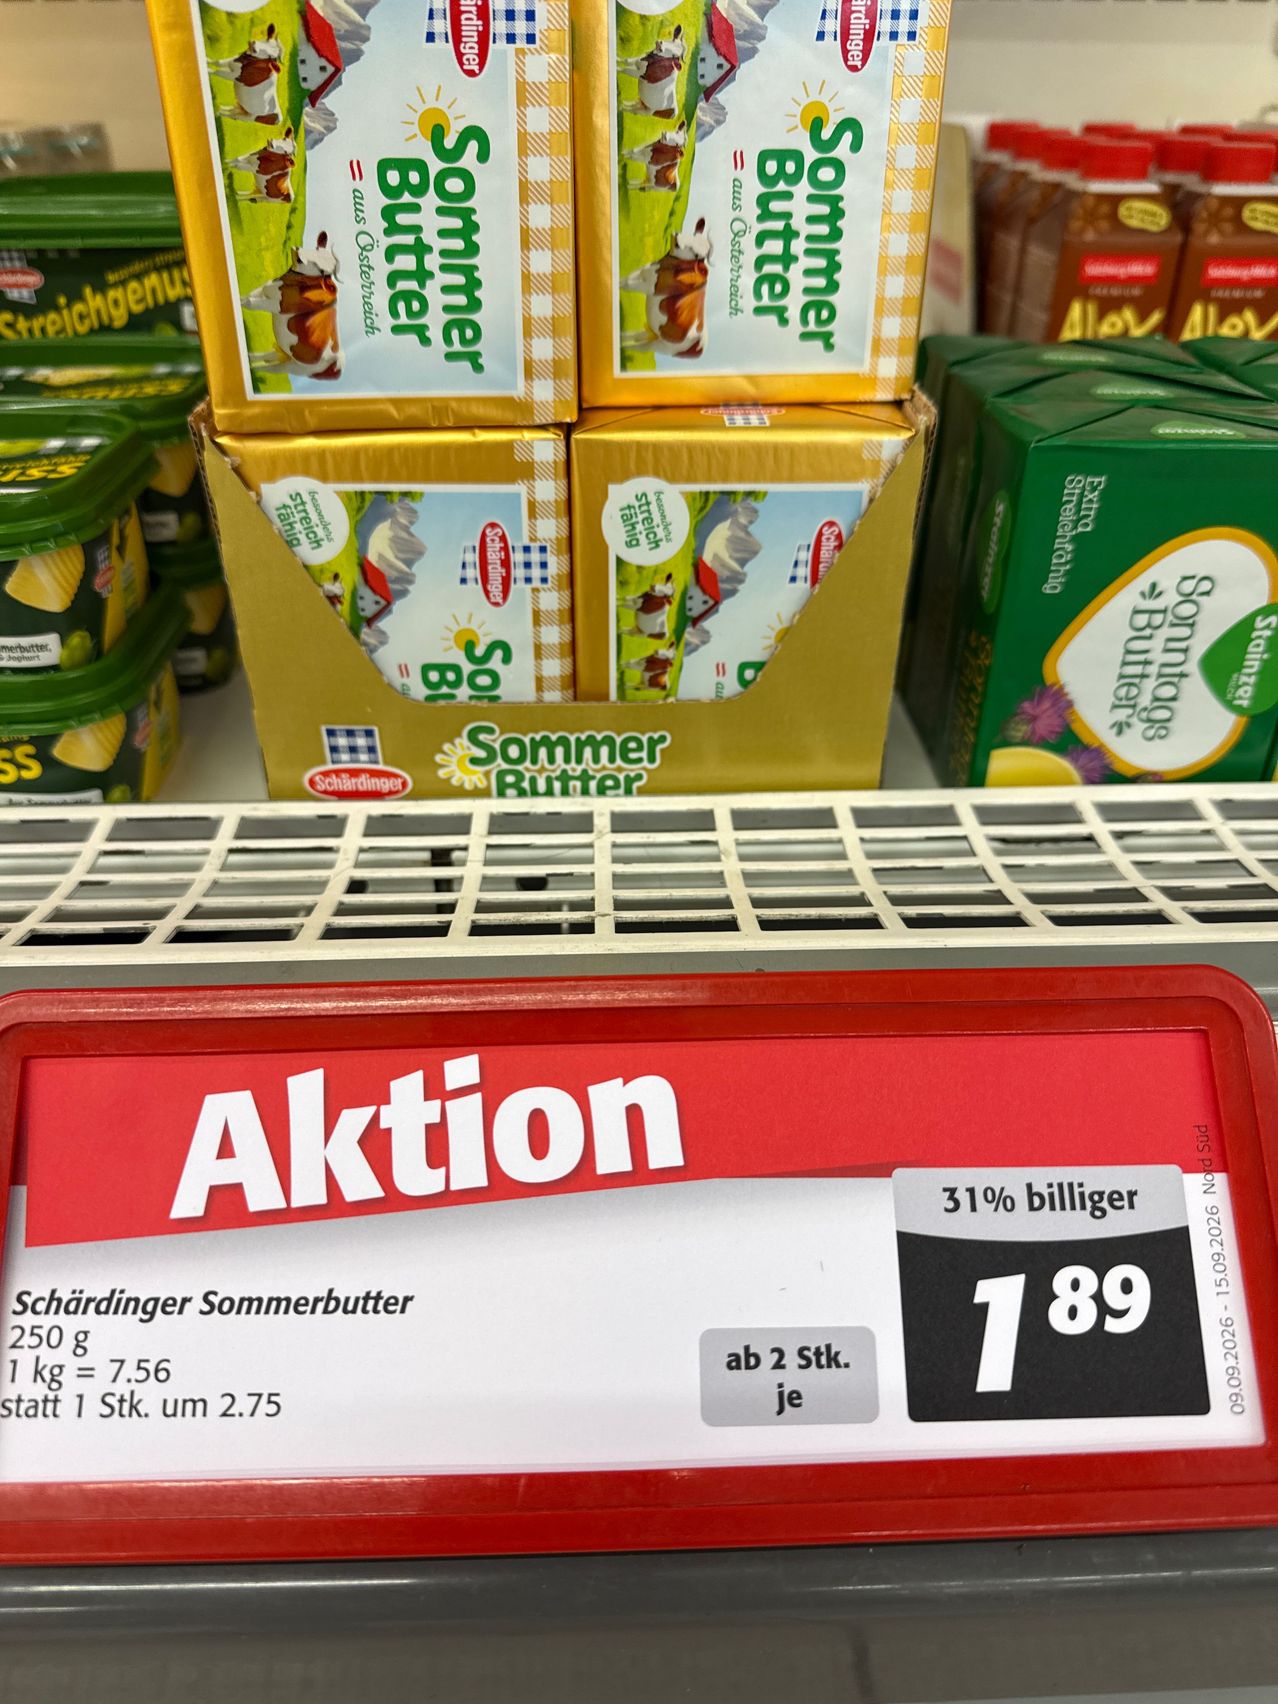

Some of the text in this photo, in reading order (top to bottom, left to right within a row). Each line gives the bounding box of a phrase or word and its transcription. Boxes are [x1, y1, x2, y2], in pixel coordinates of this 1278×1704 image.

[352, 188, 381, 338] aus Österreich
[376, 157, 435, 348] Butter
[430, 123, 491, 375] Sommer
[729, 177, 752, 318] aus Österreich
[752, 148, 805, 328] Butter
[798, 116, 864, 353] Sommer
[289, 492, 323, 551] streich
[308, 489, 334, 543] besonders
[619, 503, 642, 549] fähig
[635, 492, 663, 551] streich
[654, 490, 673, 543] besonders
[1077, 475, 1107, 533] Extra
[1041, 474, 1085, 595] Streichfähig
[485, 526, 507, 606] Schärdinger
[0, 643, 52, 654] merbutter,
[464, 639, 513, 702] So
[1109, 605, 1168, 719] Butter
[1137, 575, 1216, 742] Sonntags
[1232, 613, 1278, 708] Stainzer
[421, 662, 464, 702] B
[467, 725, 668, 767] Sommer
[314, 775, 404, 794] Schärdinger
[495, 768, 645, 797] Butter
[168, 1053, 685, 1220] Aktion
[1192, 1124, 1211, 1152] Süd
[942, 1181, 1139, 1220] 31% billiger
[1196, 1158, 1216, 1195] Nord
[1205, 1204, 1231, 1297] 15.09.2026
[11, 1288, 415, 1323] Schärdinger Sommerbutter
[972, 1263, 1152, 1393] 1 89
[8, 1325, 91, 1357] 250 g
[726, 1342, 851, 1371] ab 2 Stk.
[1219, 1316, 1245, 1415] 09.09.2026
[8, 1355, 172, 1392] 1 kg = 7.56
[775, 1382, 804, 1416] je
[0, 1390, 282, 1419] statt 1 Stk. um 2.75
